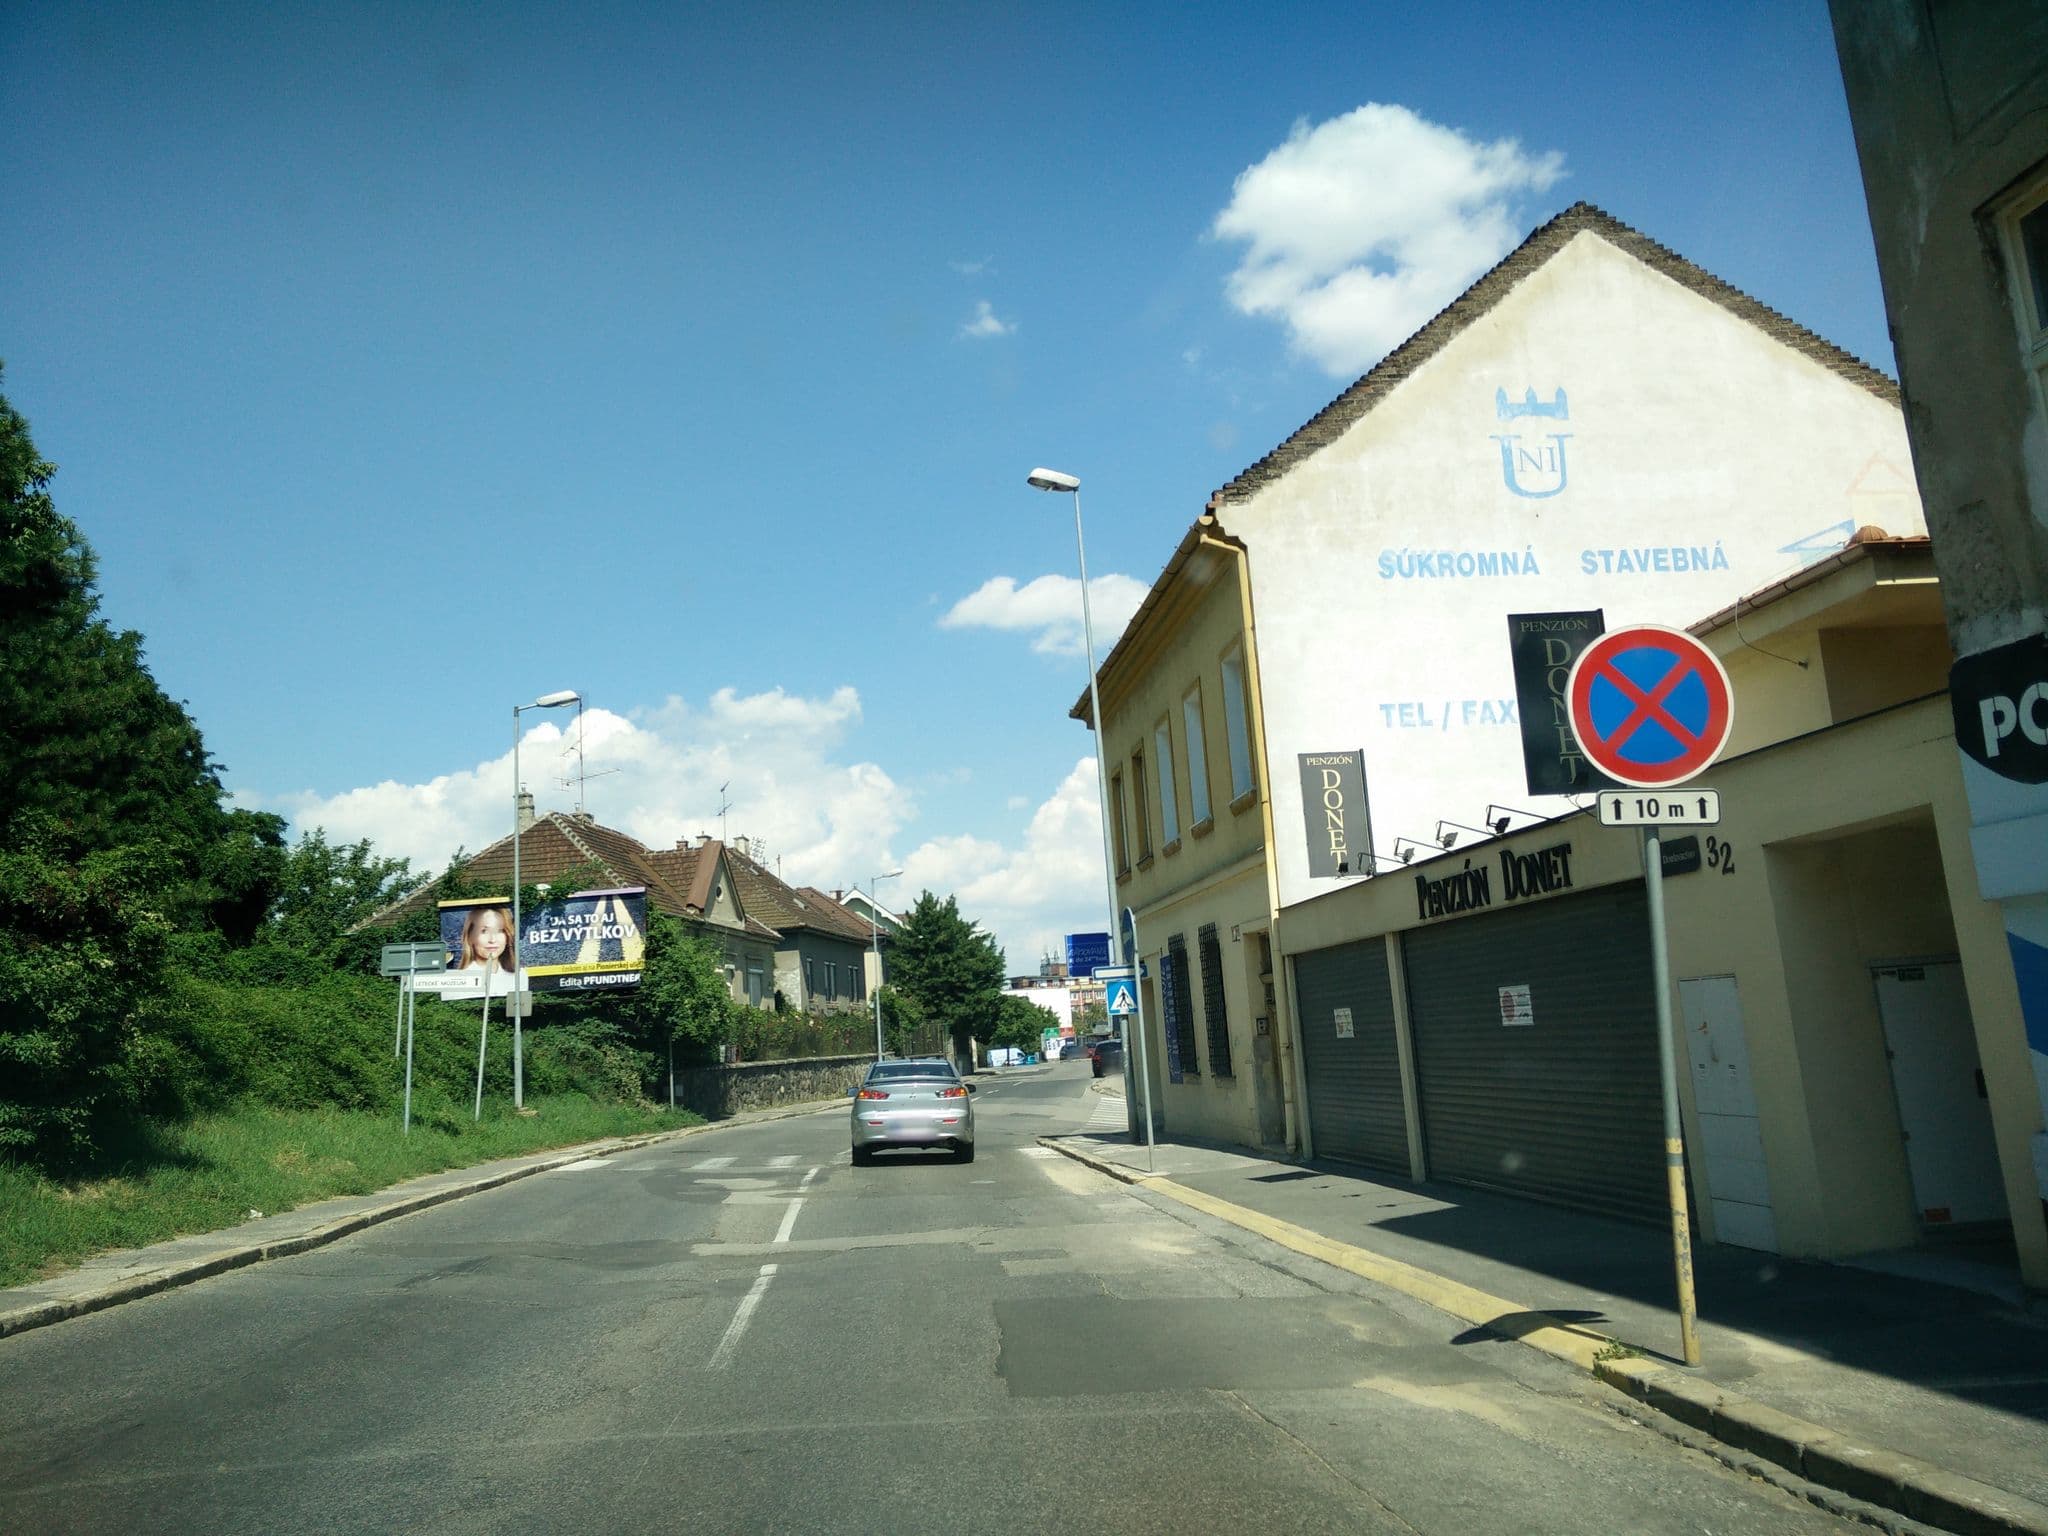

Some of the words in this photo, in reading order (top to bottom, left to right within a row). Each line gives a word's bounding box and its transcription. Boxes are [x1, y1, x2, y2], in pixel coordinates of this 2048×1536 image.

[1378, 545, 1540, 579] SÚKROMNÁ
[1580, 540, 1729, 575] STAVEBNÁ
[1520, 619, 1588, 632] PENZIÓN
[1379, 702, 1433, 728] TEL
[1462, 699, 1518, 725] FAX
[1306, 755, 1352, 766] PENZIÓN
[1636, 798, 1660, 818] 10
[1668, 804, 1684, 817] m
[1321, 769, 1347, 872] DONET
[1706, 836, 1735, 876] 32
[1415, 859, 1491, 920] PENZIÓN
[1499, 843, 1573, 901] DONET
[583, 913, 599, 924] TO
[601, 912, 614, 923] AJ
[529, 929, 560, 944] BEZ
[561, 923, 635, 941] VÝTLKOV
[559, 977, 582, 987] Edita
